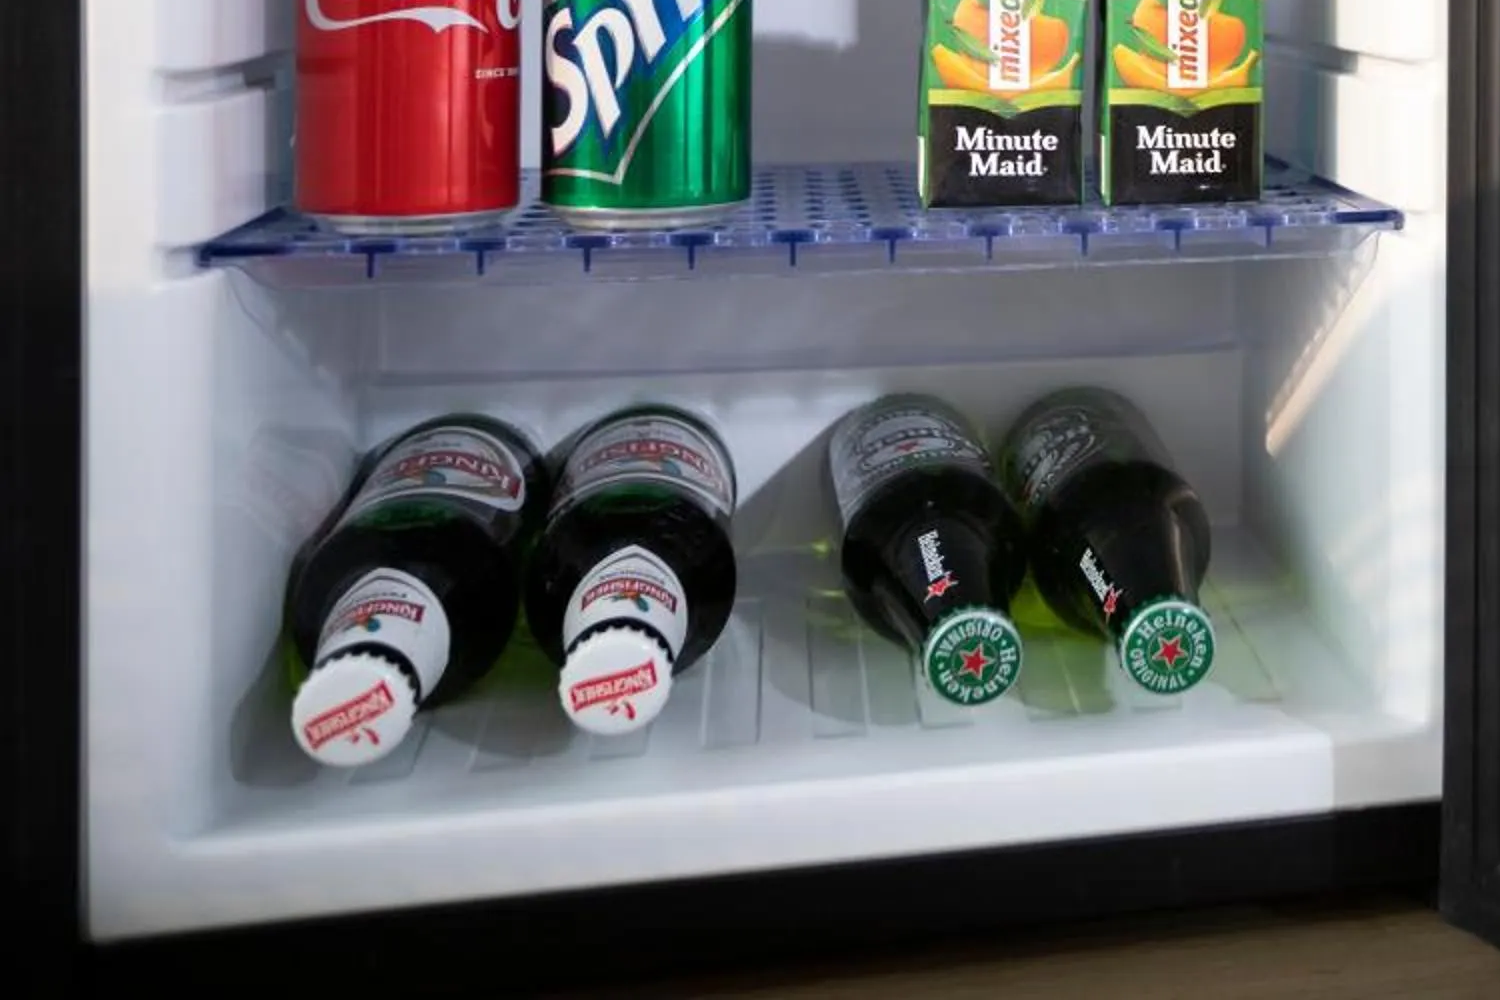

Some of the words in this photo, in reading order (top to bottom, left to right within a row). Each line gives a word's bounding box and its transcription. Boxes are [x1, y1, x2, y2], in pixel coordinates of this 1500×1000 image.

[954, 126, 1059, 152] Minute
[1136, 125, 1237, 149] Minute
[968, 152, 1044, 177] Maid
[1150, 150, 1222, 175] Maid
[935, 619, 1003, 658] ORIGINAL
[1136, 609, 1207, 669] Heineken
[939, 646, 1017, 703] Heineken
[1129, 647, 1188, 690] ORIGINAL
